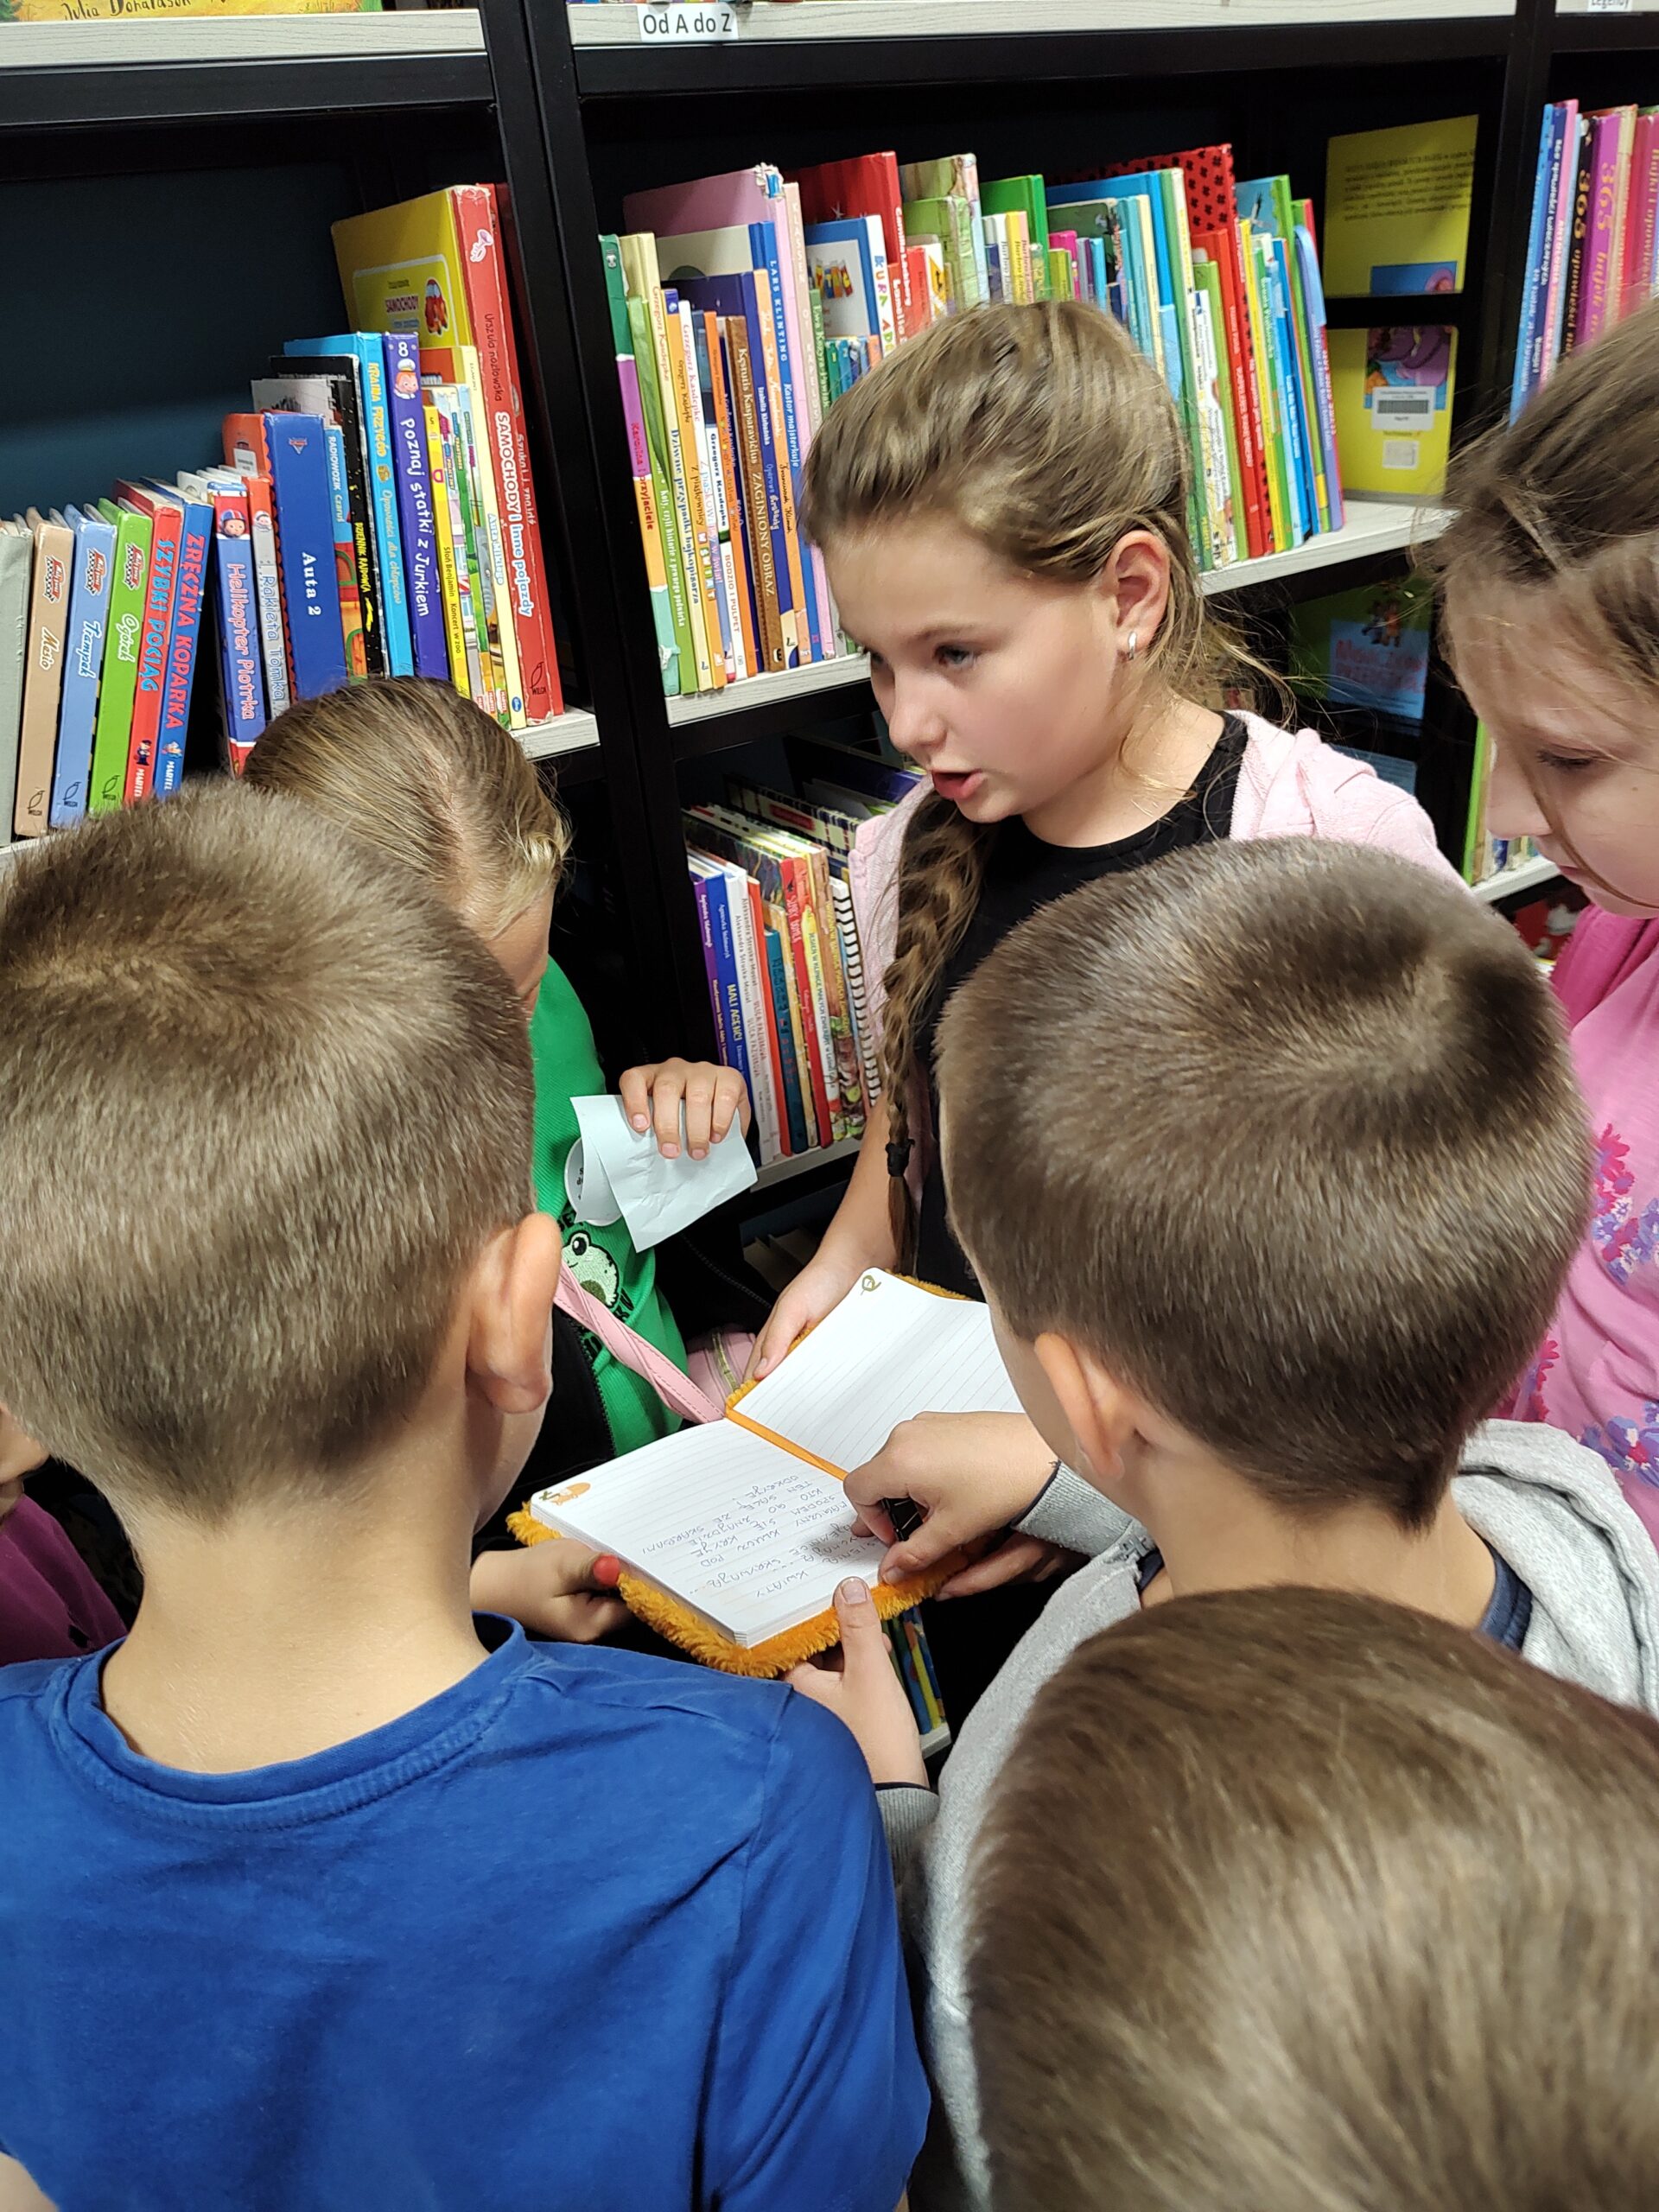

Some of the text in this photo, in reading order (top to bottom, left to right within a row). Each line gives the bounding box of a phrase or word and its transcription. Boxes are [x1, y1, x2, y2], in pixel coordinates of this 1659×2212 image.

[64, 3, 99, 21] Julia
[643, 12, 732, 34] Od A do Z
[1574, 170, 1590, 238] 365
[1598, 162, 1615, 230] 365
[770, 260, 779, 293] LARS
[874, 255, 888, 307] KURA
[484, 313, 496, 350] Urszula
[652, 286, 663, 331] Grzegorz
[774, 298, 788, 361] KLINTING
[398, 341, 409, 357] 8
[683, 324, 692, 372] Grzegorz
[368, 362, 382, 402] KRAINA
[743, 394, 760, 464] Kasparavičius
[784, 384, 800, 467] Kastor majsterkuje
[327, 435, 342, 491] RADIOWOZIK
[495, 411, 522, 514] SAMOCHODY
[632, 423, 644, 465] Karolina
[639, 476, 654, 531] przyjaciele
[710, 433, 726, 526] Grzegorz Kasdepke
[410, 482, 434, 534] statki
[664, 511, 672, 527] czyli
[671, 429, 698, 605] Dziwne przypadki bajkopisarza
[691, 477, 703, 526] piaskownicy
[387, 542, 398, 558] dla
[416, 539, 429, 549] z
[488, 514, 499, 542] Auta
[510, 524, 524, 557] inne
[665, 529, 676, 556] historie
[753, 473, 775, 597] ZAGINIONY OBRAZ
[354, 522, 372, 593] DZIENNIK RAJDOWCA
[669, 564, 680, 594] pewnego
[302, 552, 321, 616] Auta 2
[414, 553, 430, 617] Jurkiem
[445, 564, 455, 597] Benjamin
[450, 603, 459, 633] Koncert
[512, 559, 534, 617] pojazdy
[725, 554, 734, 591] BODZIO
[730, 598, 740, 632] PULPET
[138, 539, 175, 691] SZYBKI POCIĄG
[164, 532, 206, 728] ZRĘCZNA KOPARKA
[673, 594, 684, 626] podwórka
[78, 621, 101, 677] Trampek
[117, 614, 139, 663] Ogórek
[227, 563, 257, 720] Helikopter Piotrka
[262, 575, 285, 701] Rakieta Tomka
[734, 915, 745, 952] Aleksandra
[741, 899, 750, 936] Aleksandra
[727, 984, 738, 1007] MALI
[730, 1009, 742, 1041] AGENCI
[786, 1481, 813, 1493] TEN
[791, 1495, 836, 1516] SPODEM
[688, 1489, 823, 1546] KTO GO ZNAJDZIE
[737, 1529, 781, 1552] KLUCZ
[789, 1522, 851, 1555] AJEMNICE
[690, 1535, 738, 1557] KRYJE
[700, 1554, 725, 1567] POD
[757, 1570, 808, 1597] KWIATY
